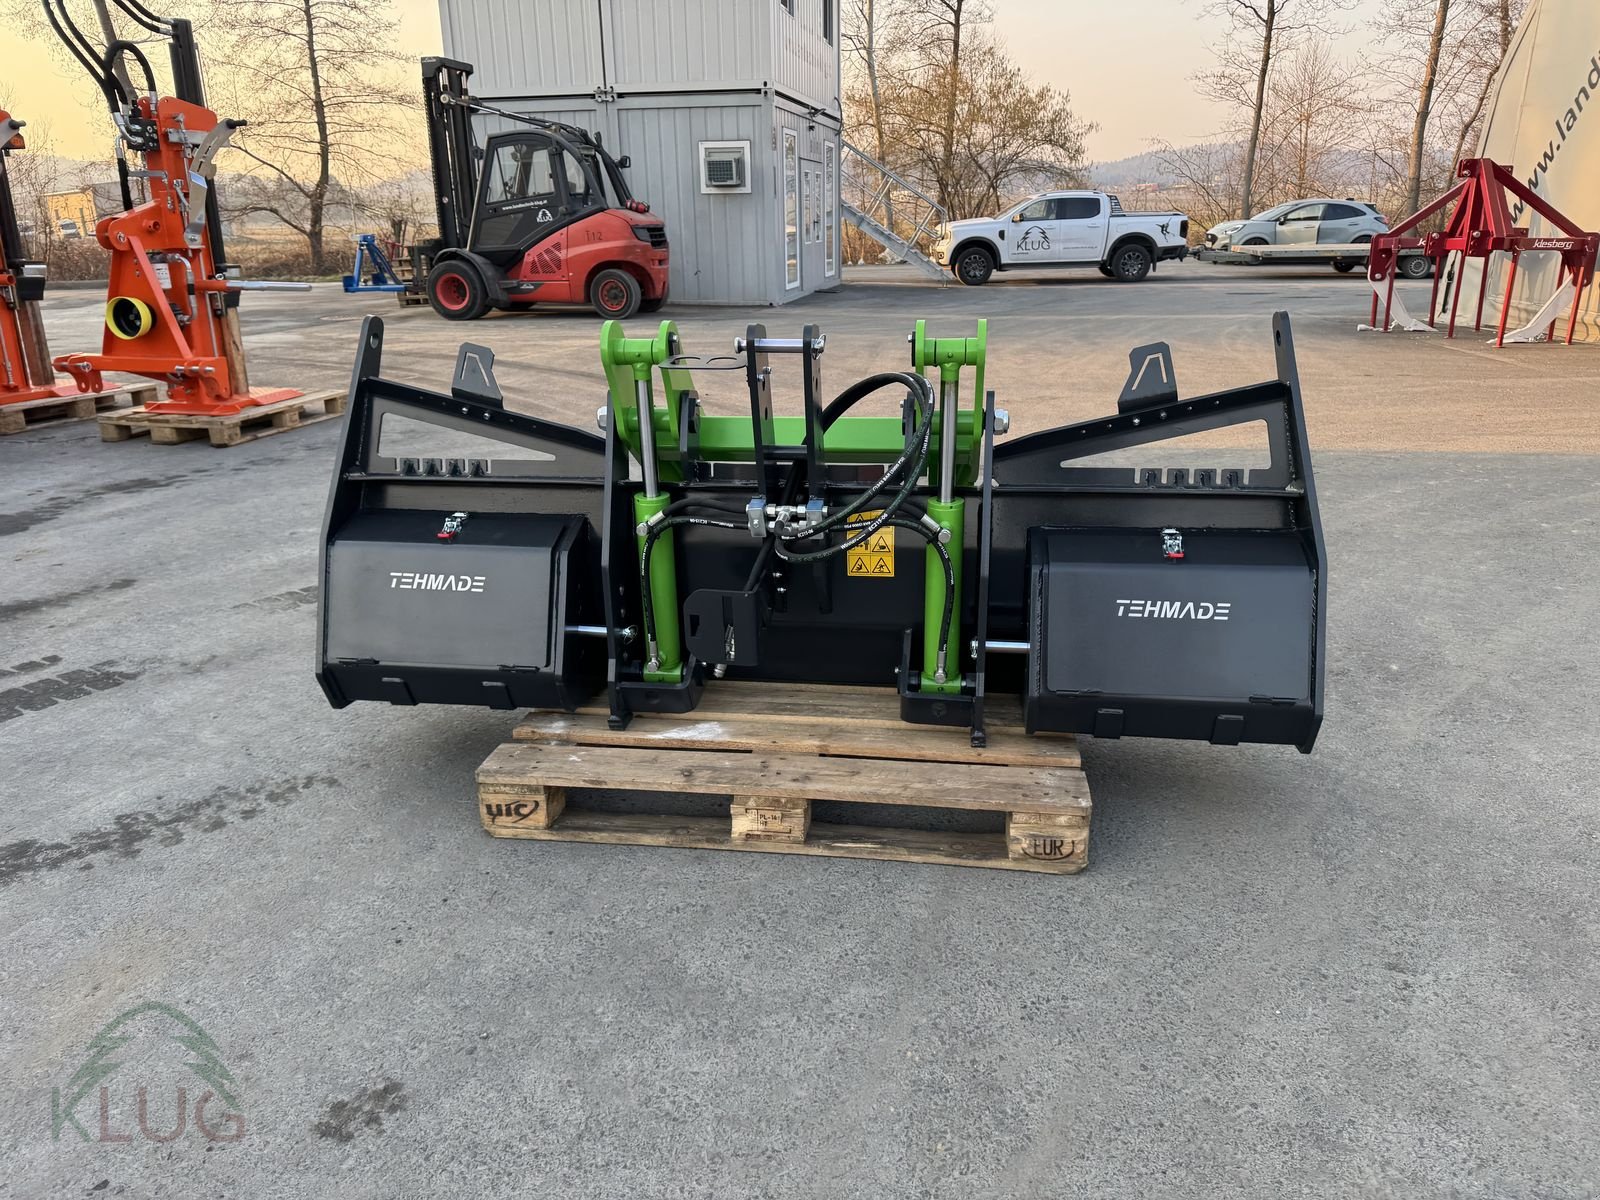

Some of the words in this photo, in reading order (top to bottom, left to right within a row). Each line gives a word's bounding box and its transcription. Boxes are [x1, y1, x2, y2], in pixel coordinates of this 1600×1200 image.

[1510, 50, 1600, 225] www.land
[1016, 240, 1051, 251] KLUG
[390, 572, 486, 593] TEHMADE
[1116, 599, 1231, 621] TEHMADE
[1033, 839, 1064, 856] EUR
